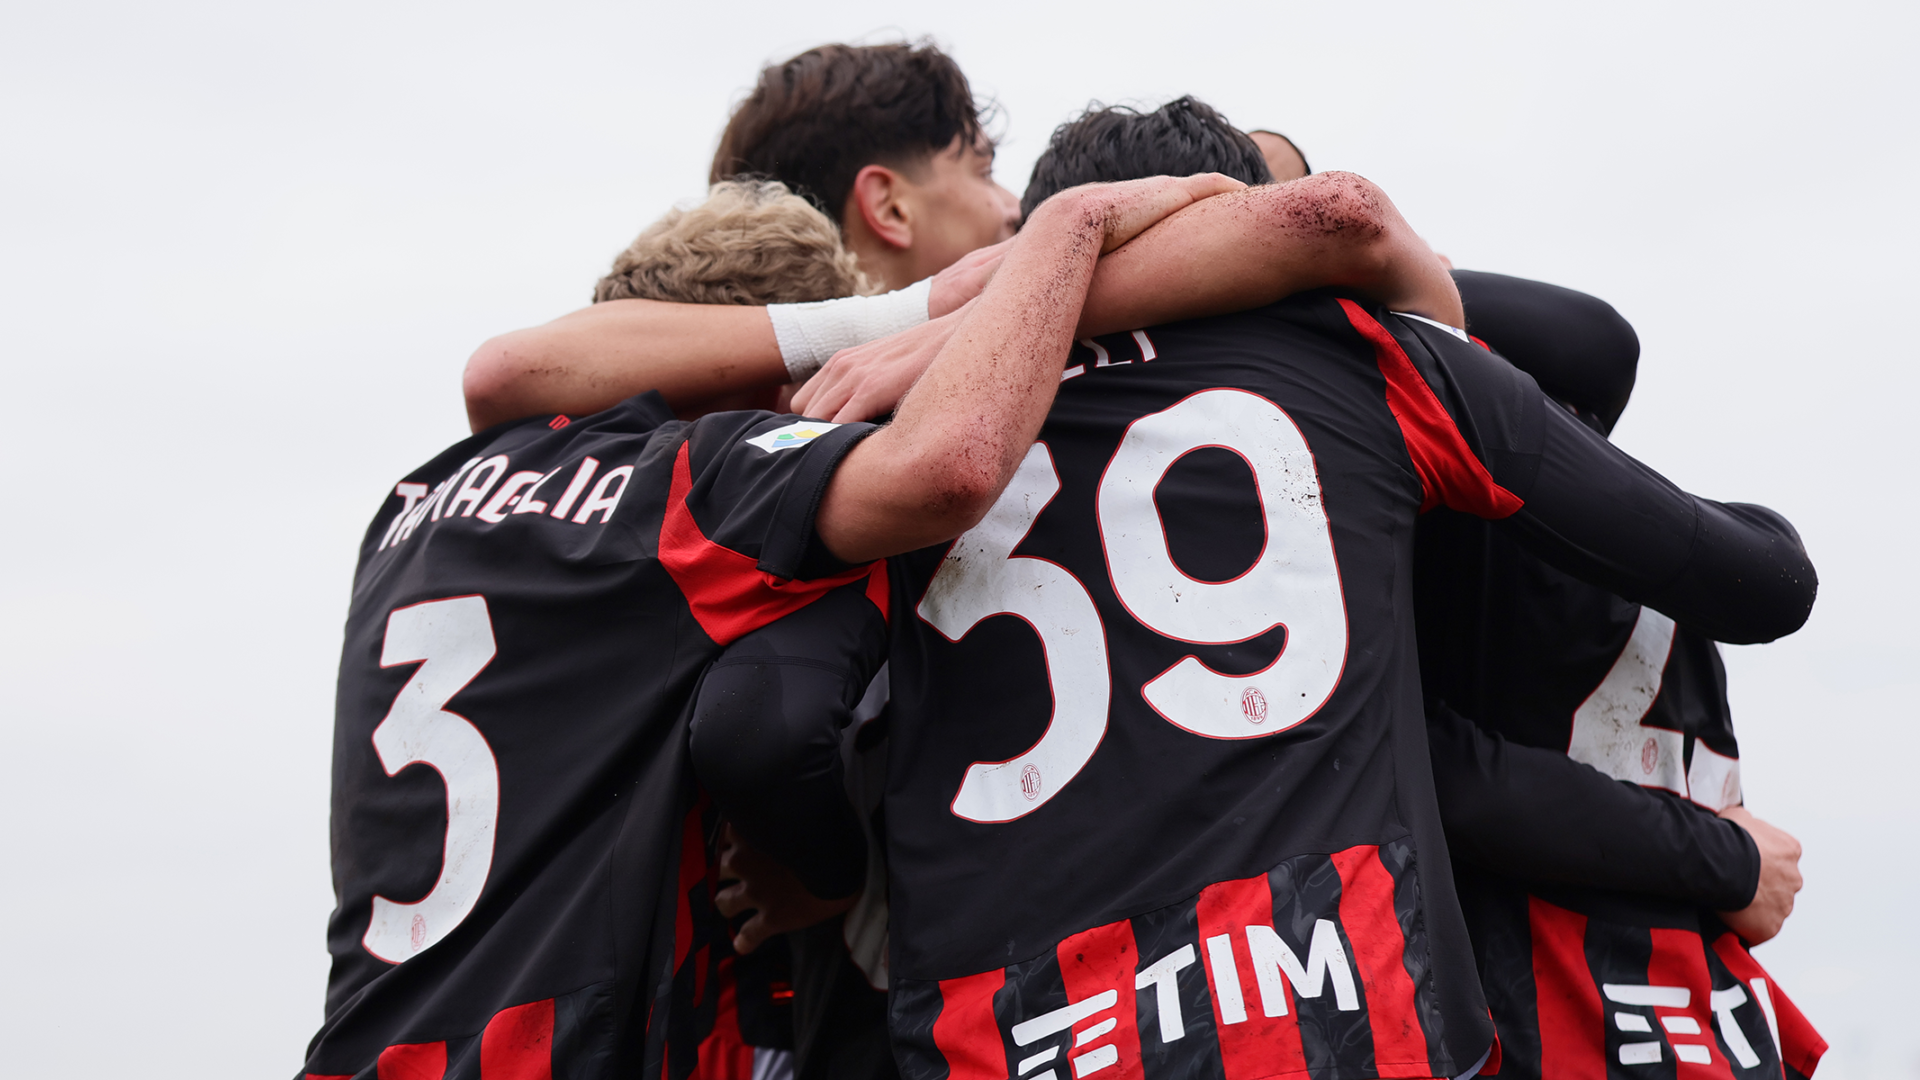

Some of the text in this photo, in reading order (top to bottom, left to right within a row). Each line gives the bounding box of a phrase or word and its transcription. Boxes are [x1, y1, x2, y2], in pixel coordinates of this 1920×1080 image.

[378, 454, 634, 552] TATAGLIA
[915, 387, 1349, 824] 39
[361, 594, 500, 966] 3
[1567, 604, 1742, 815] 2
[1135, 918, 1360, 1044] TIM
